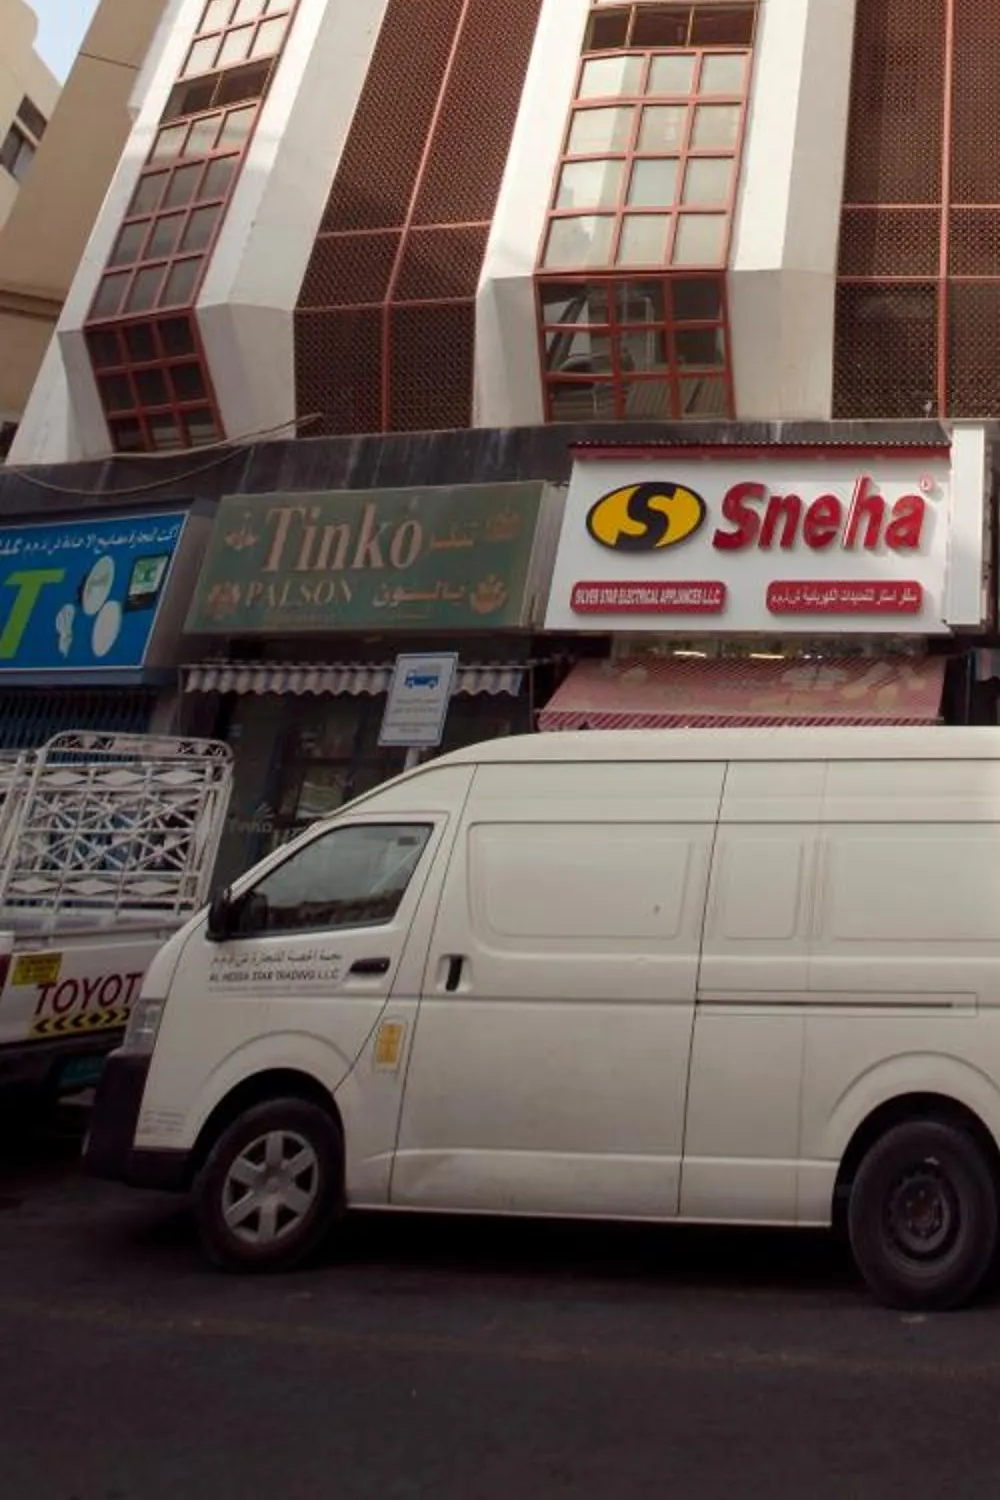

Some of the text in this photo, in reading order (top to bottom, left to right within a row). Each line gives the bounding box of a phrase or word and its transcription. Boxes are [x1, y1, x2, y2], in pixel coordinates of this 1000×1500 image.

[261, 503, 423, 572] Tinko
[712, 474, 927, 550] Sneha
[35, 973, 143, 1015] TOYOT
